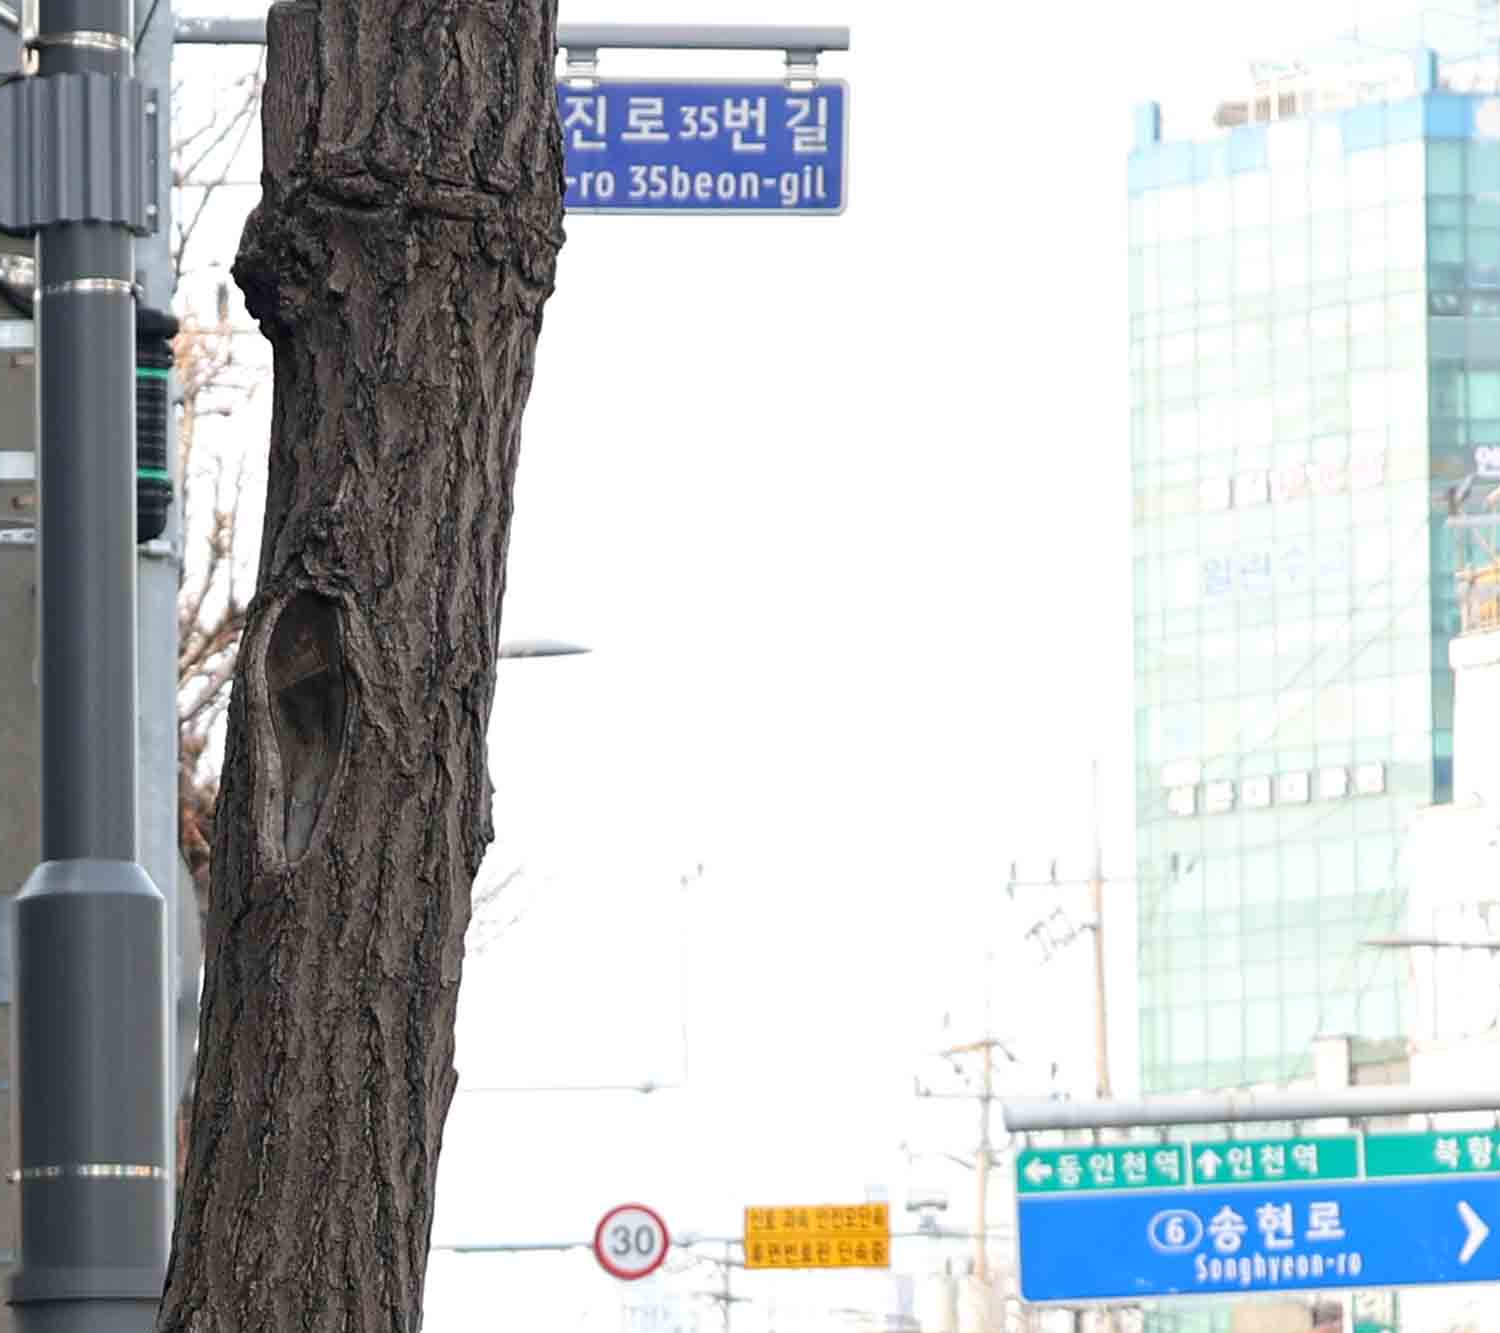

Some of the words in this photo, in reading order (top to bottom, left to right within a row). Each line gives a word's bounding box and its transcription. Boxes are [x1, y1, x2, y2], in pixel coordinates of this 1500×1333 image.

[629, 165, 827, 205] 35beon-gil
[1055, 1148, 1181, 1187] 동인천역
[1226, 1140, 1320, 1178] 인천역
[610, 1225, 656, 1257] 30
[1164, 1218, 1185, 1244] 6
[1208, 1200, 1346, 1252] 송현로
[1195, 1250, 1362, 1287] Songhyeon-ro
